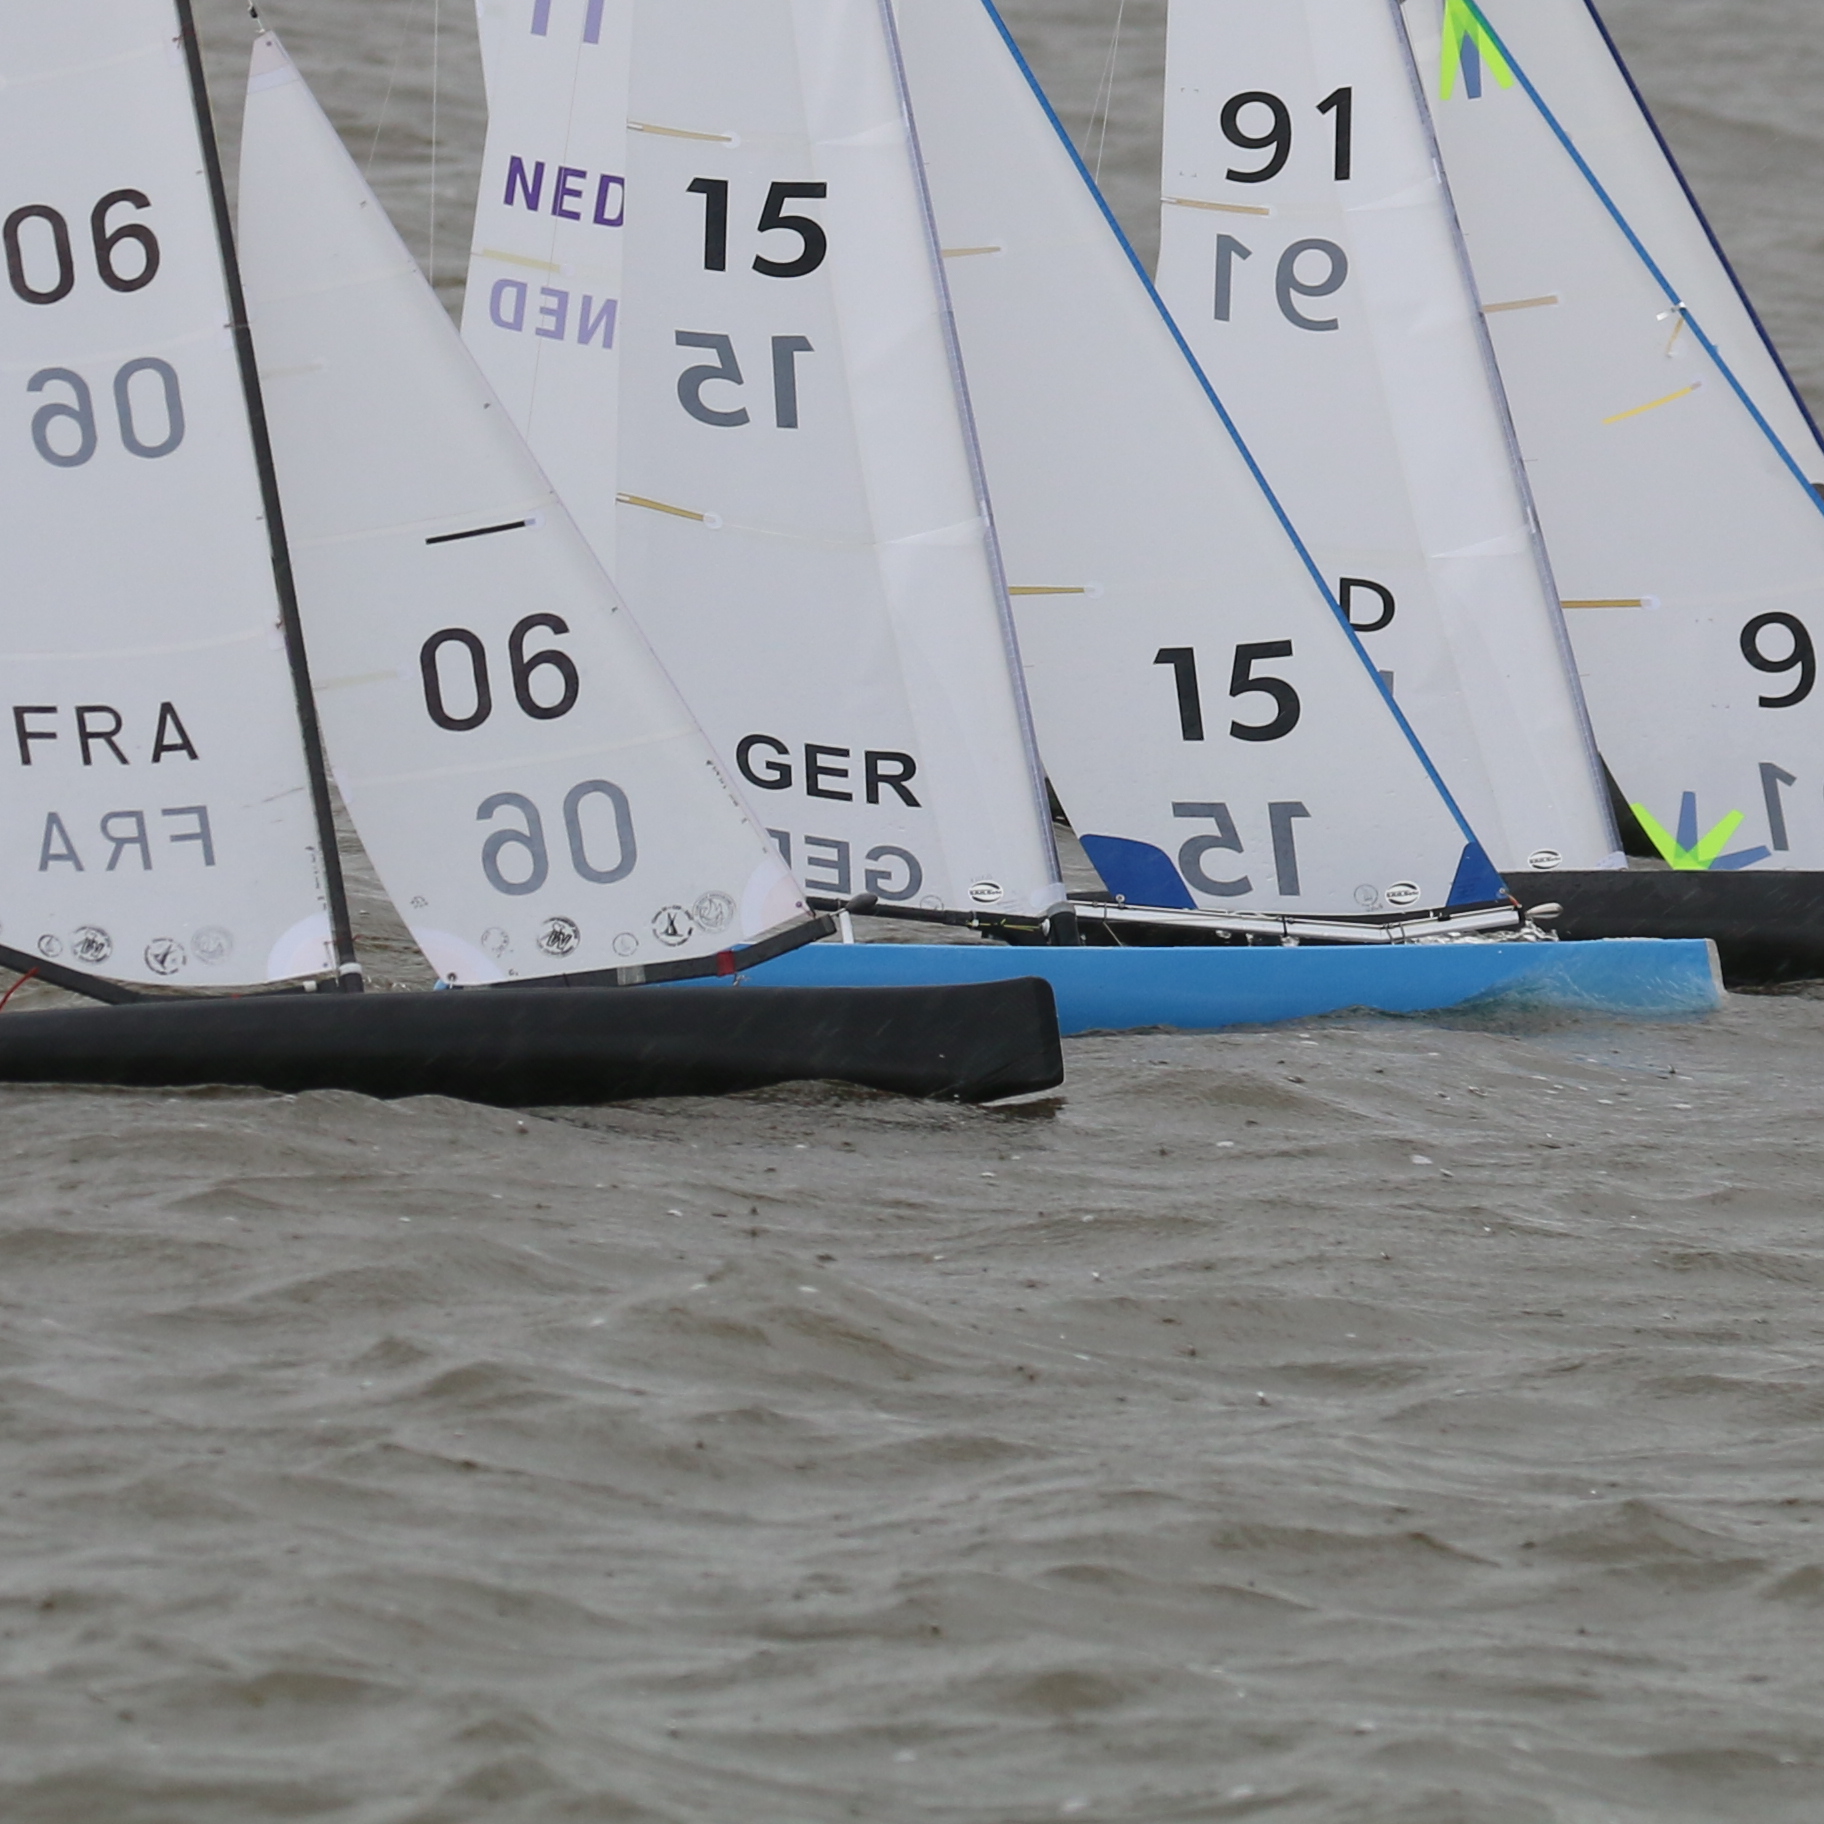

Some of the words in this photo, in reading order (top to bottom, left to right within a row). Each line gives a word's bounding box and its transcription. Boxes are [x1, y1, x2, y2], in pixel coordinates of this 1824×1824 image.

[1221, 87, 1351, 183] 91
[504, 156, 624, 227] NED
[687, 178, 826, 278] 15
[3, 189, 159, 304] 06
[420, 613, 579, 731] 06
[1154, 640, 1300, 741] 15
[13, 702, 198, 765] FRA
[736, 734, 921, 807] GER
